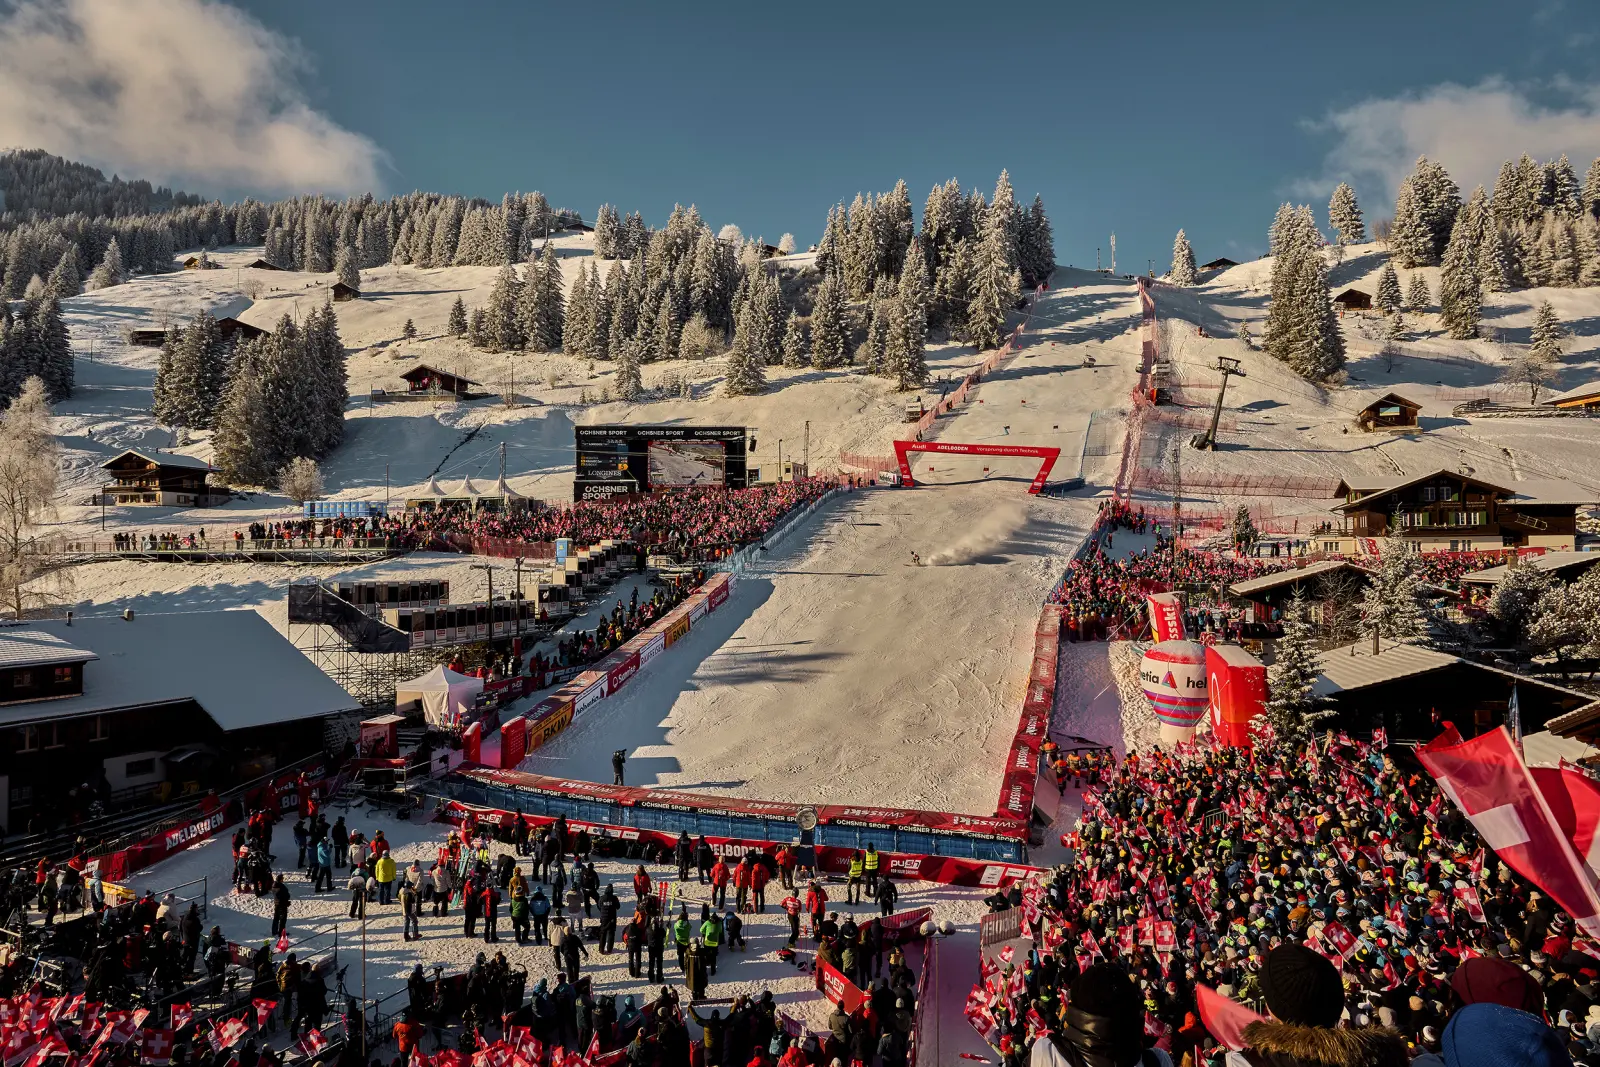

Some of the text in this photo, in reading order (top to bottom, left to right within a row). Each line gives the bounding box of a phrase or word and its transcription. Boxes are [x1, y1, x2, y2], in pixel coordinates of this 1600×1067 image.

[585, 485, 628, 493] OCHSNER
[582, 492, 613, 500] SPORT
[672, 623, 687, 641] BKW
[543, 714, 568, 741] BKW
[491, 780, 510, 788] SPORT
[515, 784, 561, 797] OCHSNER SPORT
[567, 793, 595, 802] OCHSNER
[641, 801, 670, 810] OCHSNER
[697, 807, 748, 818] OCHSNER SPORT
[755, 814, 786, 822] OCHSNER
[836, 819, 867, 828] OCHSNER
[868, 822, 891, 830] SPORT
[165, 811, 224, 850] ADELBODEN
[898, 825, 954, 836] OCHSNER SPORT
[996, 835, 1019, 843] SPORT
